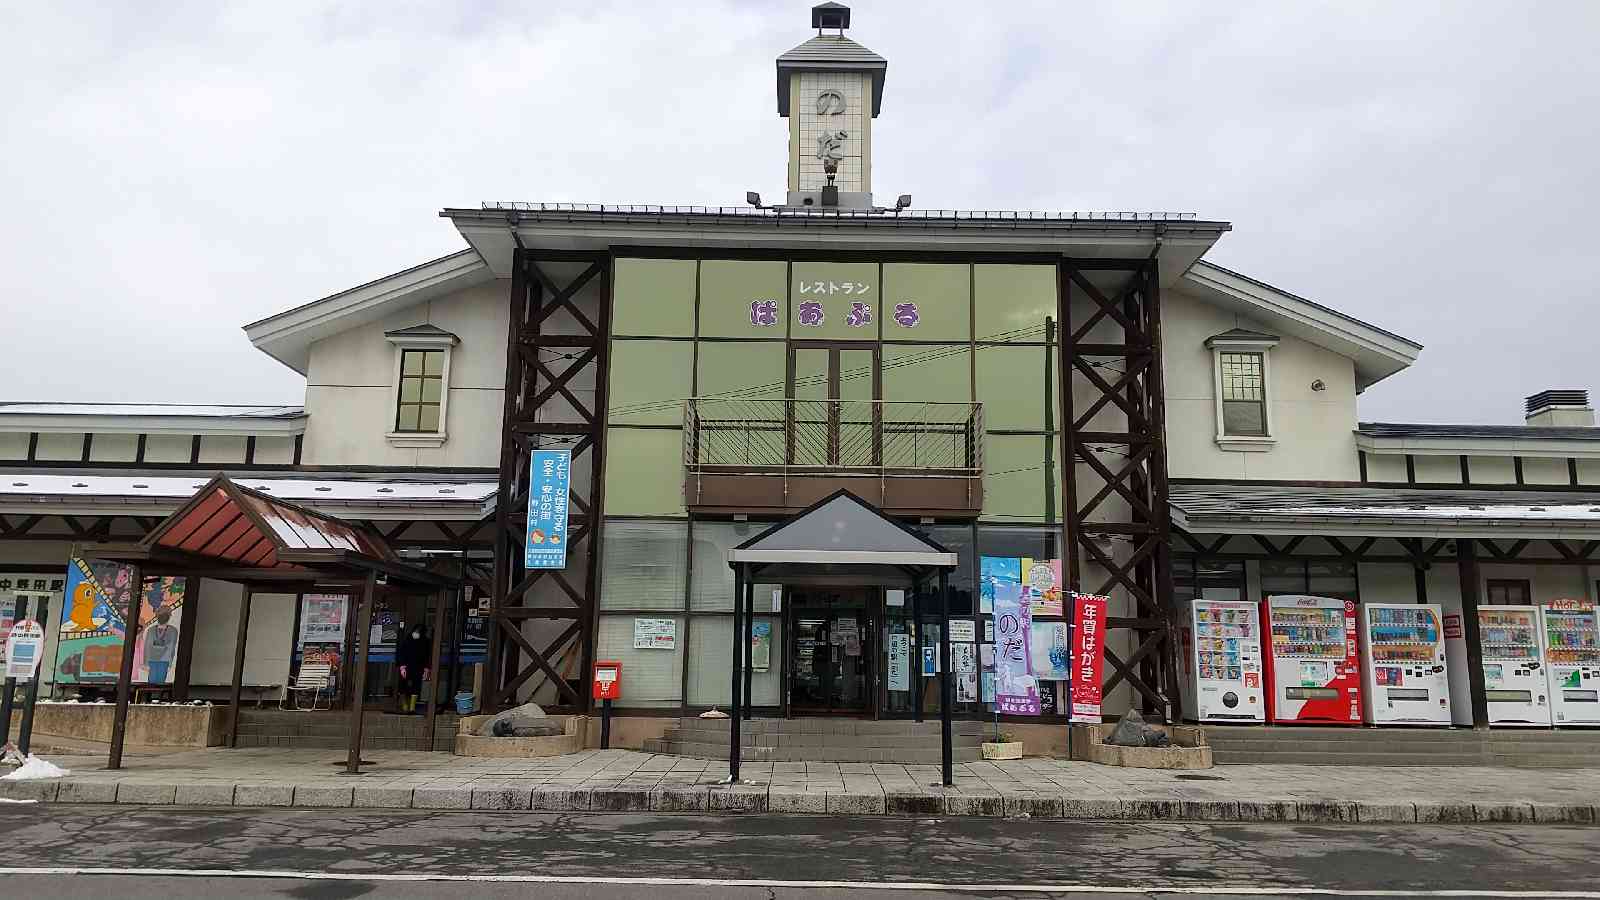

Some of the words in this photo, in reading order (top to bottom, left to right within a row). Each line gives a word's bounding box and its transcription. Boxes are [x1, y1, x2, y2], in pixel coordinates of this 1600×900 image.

[816, 88, 849, 160] のだ
[750, 300, 920, 328] ぱあぷる
[799, 280, 870, 297] レストラン
[540, 459, 554, 521] 安全・安心の街
[1000, 614, 1024, 661] のだ
[1081, 604, 1098, 682] 年賀はがき
